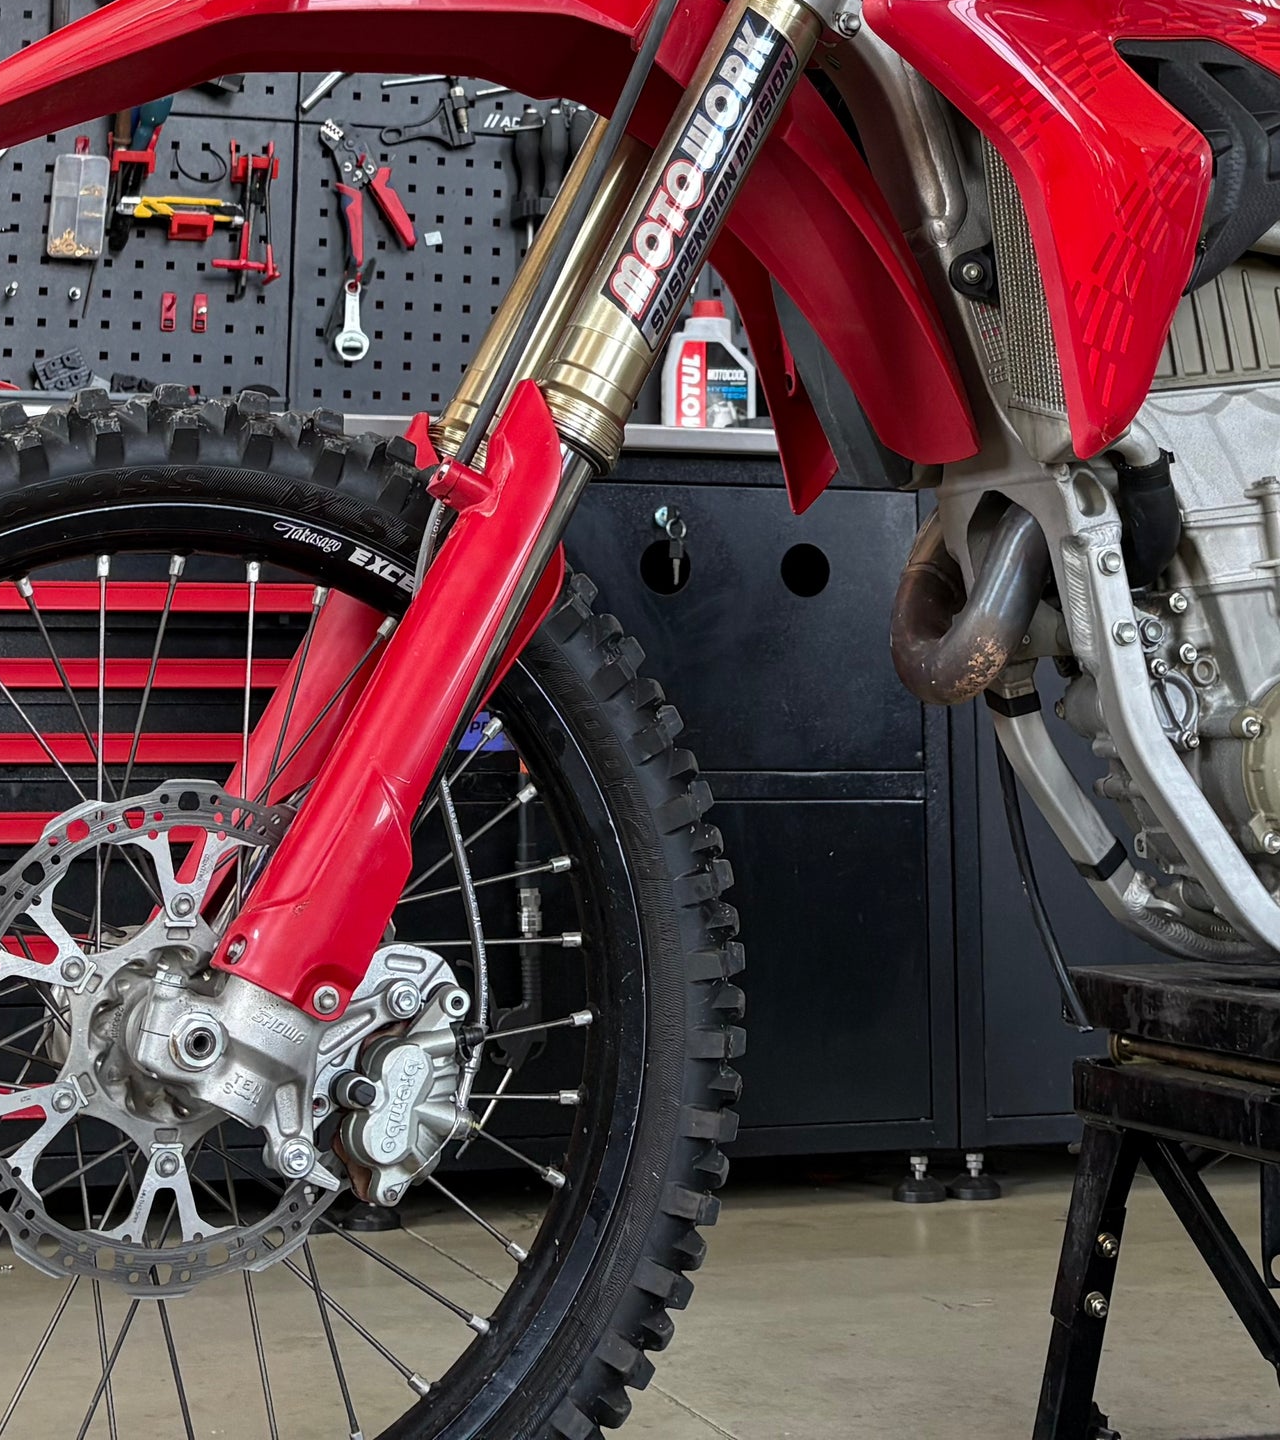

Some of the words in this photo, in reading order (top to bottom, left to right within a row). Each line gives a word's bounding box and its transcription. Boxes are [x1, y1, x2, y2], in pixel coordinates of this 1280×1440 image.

[651, 162, 739, 337] SUSPENSION
[735, 50, 794, 172] DIVISION
[273, 521, 343, 553] Takasago
[347, 546, 416, 593] EXCE
[250, 1009, 308, 1046] SHOWA
[380, 1058, 425, 1154] brembo
